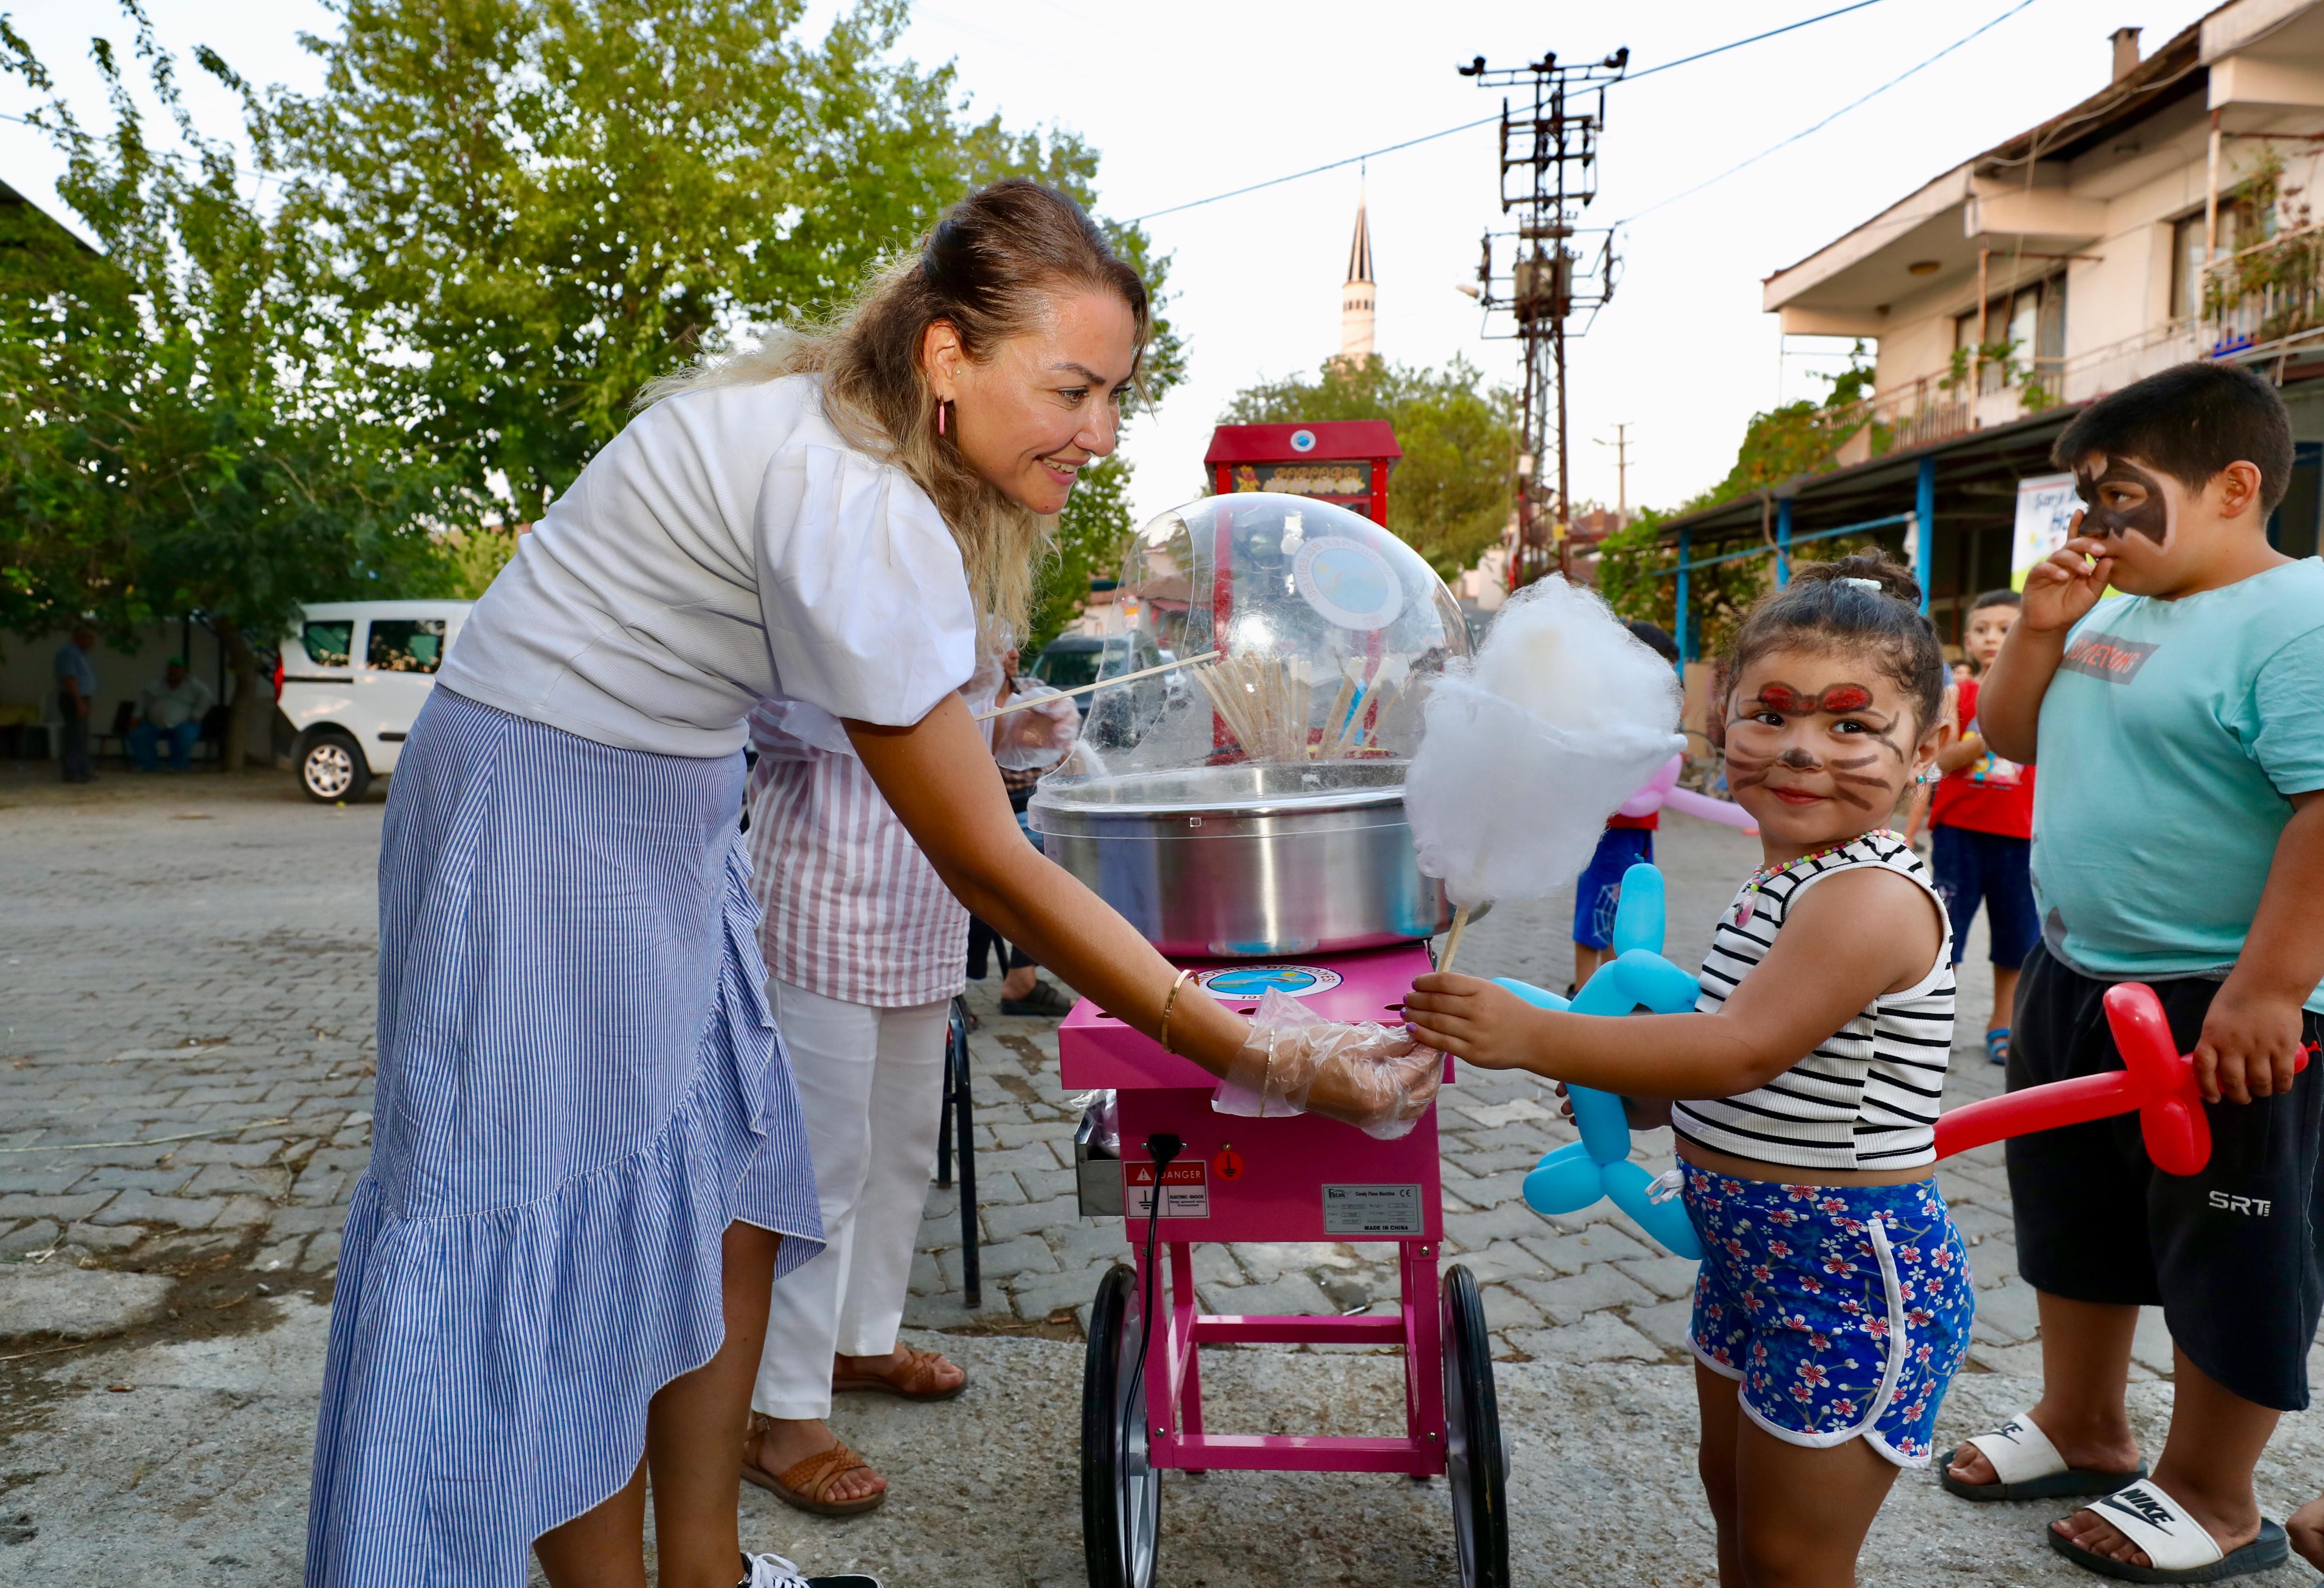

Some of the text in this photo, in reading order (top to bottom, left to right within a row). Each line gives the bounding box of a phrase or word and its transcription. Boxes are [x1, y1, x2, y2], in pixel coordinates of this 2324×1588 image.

[1161, 1171, 1201, 1179] DANGER
[2209, 1191, 2271, 1216] SRT
[2119, 1488, 2176, 1524] NIKE
